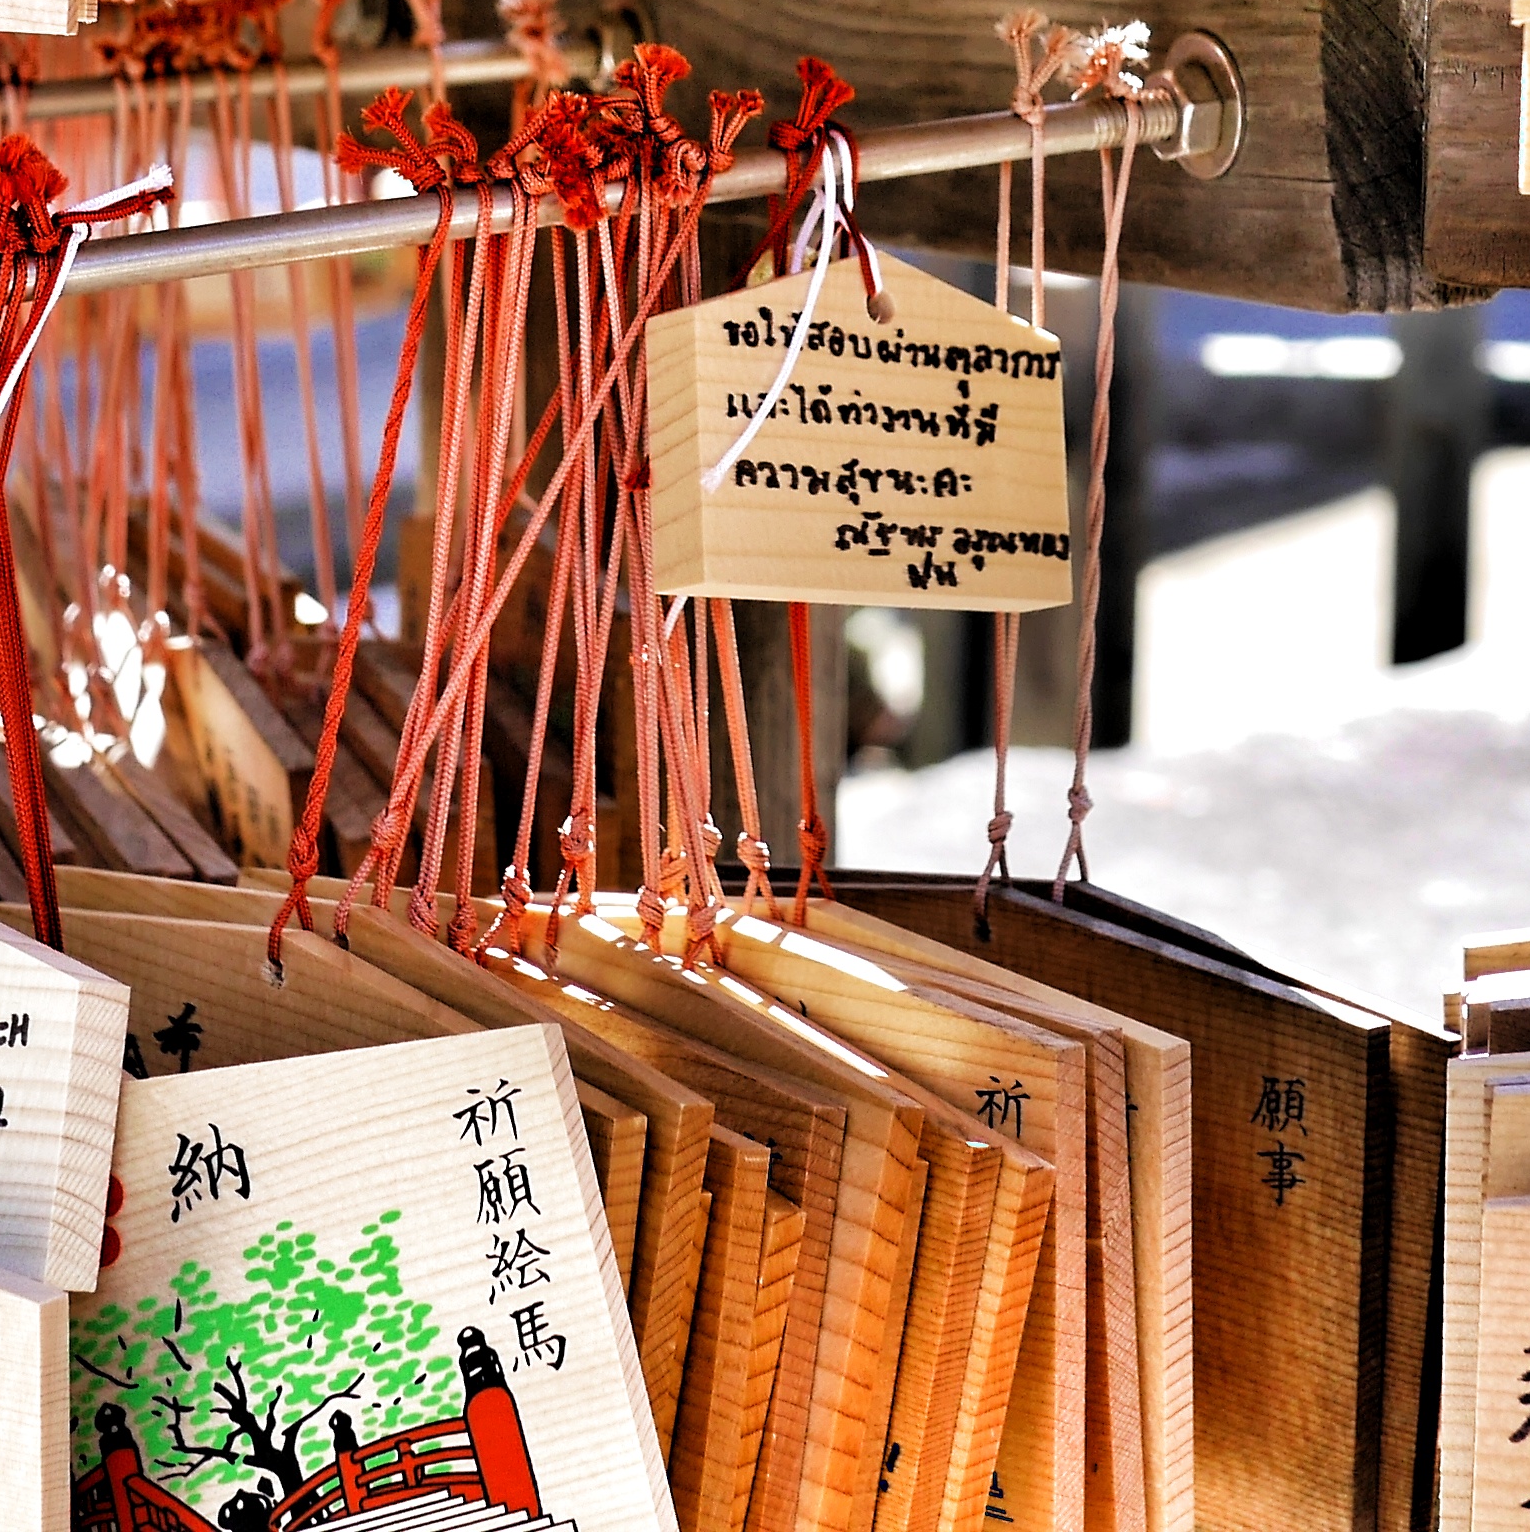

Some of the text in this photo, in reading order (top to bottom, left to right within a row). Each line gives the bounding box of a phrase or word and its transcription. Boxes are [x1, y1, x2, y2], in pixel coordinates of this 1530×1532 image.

[975, 1074, 1031, 1140] 祈
[1249, 1074, 1309, 1208] 願事
[168, 1123, 252, 1224] 納
[453, 1079, 567, 1374] 祈願絵馬
